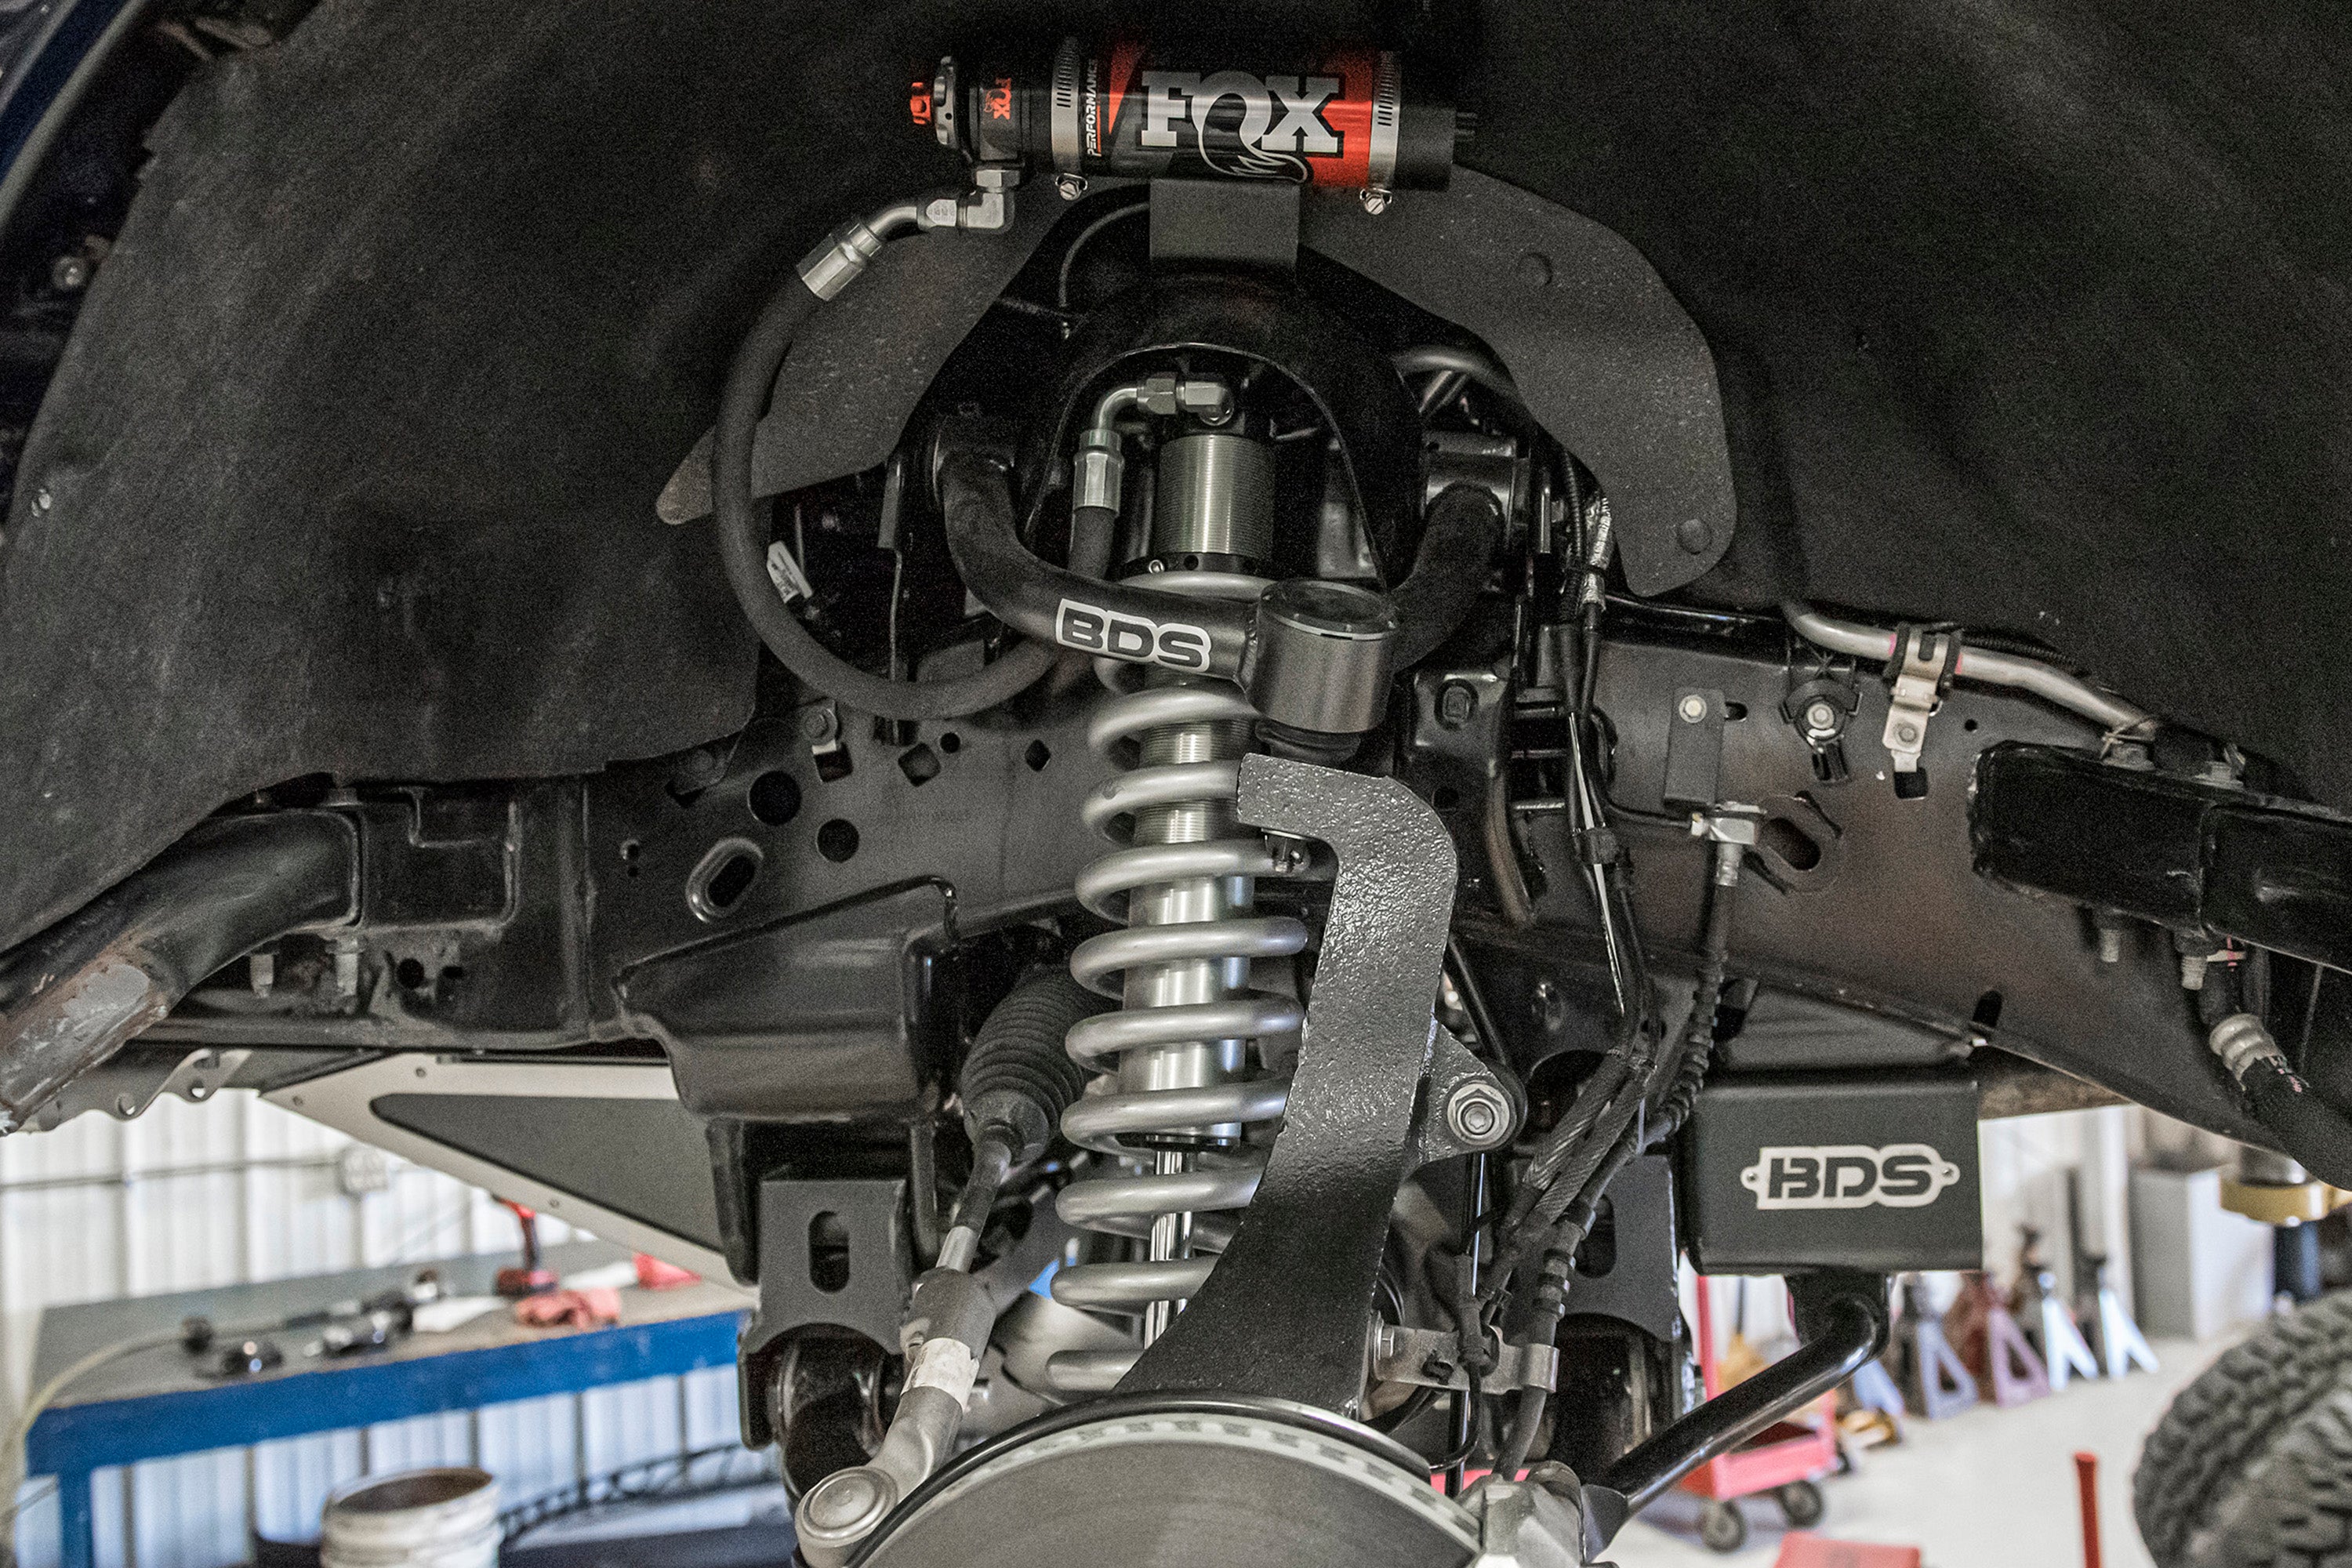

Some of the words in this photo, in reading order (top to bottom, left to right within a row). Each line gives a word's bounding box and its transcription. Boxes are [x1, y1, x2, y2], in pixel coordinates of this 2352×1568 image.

[1141, 71, 1339, 183] FOX
[1056, 598, 1211, 672] BDS
[1765, 1152, 1934, 1200] BDS
